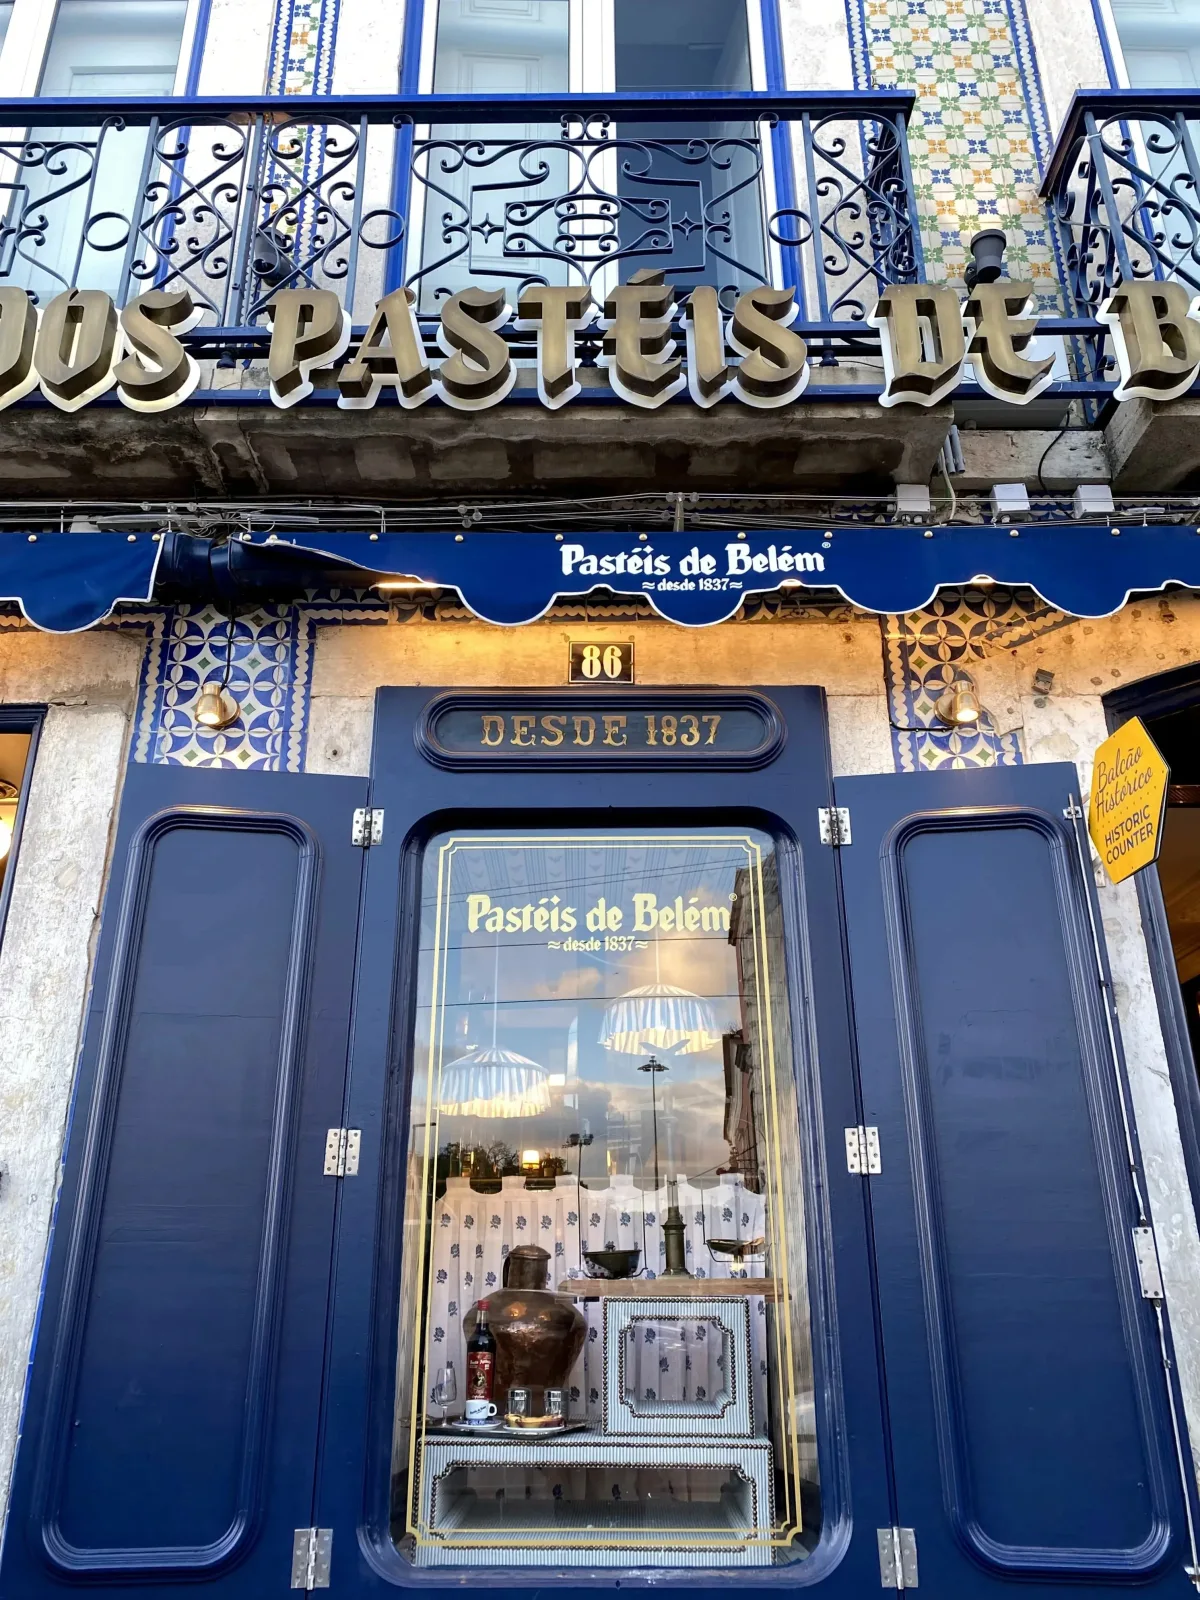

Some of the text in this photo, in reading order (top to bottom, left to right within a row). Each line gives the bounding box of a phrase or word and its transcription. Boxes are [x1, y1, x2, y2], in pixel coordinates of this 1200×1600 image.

[267, 268, 808, 403] PASTÉIS
[874, 282, 1056, 397] DE
[559, 543, 826, 576] Pastéis de Belém
[657, 578, 730, 591] desde 1837
[581, 645, 622, 679] 86
[480, 714, 722, 747] DESDE 1837
[1096, 745, 1143, 794] Balcão
[1094, 766, 1153, 823] Histórico
[1104, 804, 1151, 848] HISTORIC
[1106, 822, 1155, 865] COUNTER
[466, 892, 731, 933] Pastéis de Belém
[562, 935, 635, 952] desde 1837
